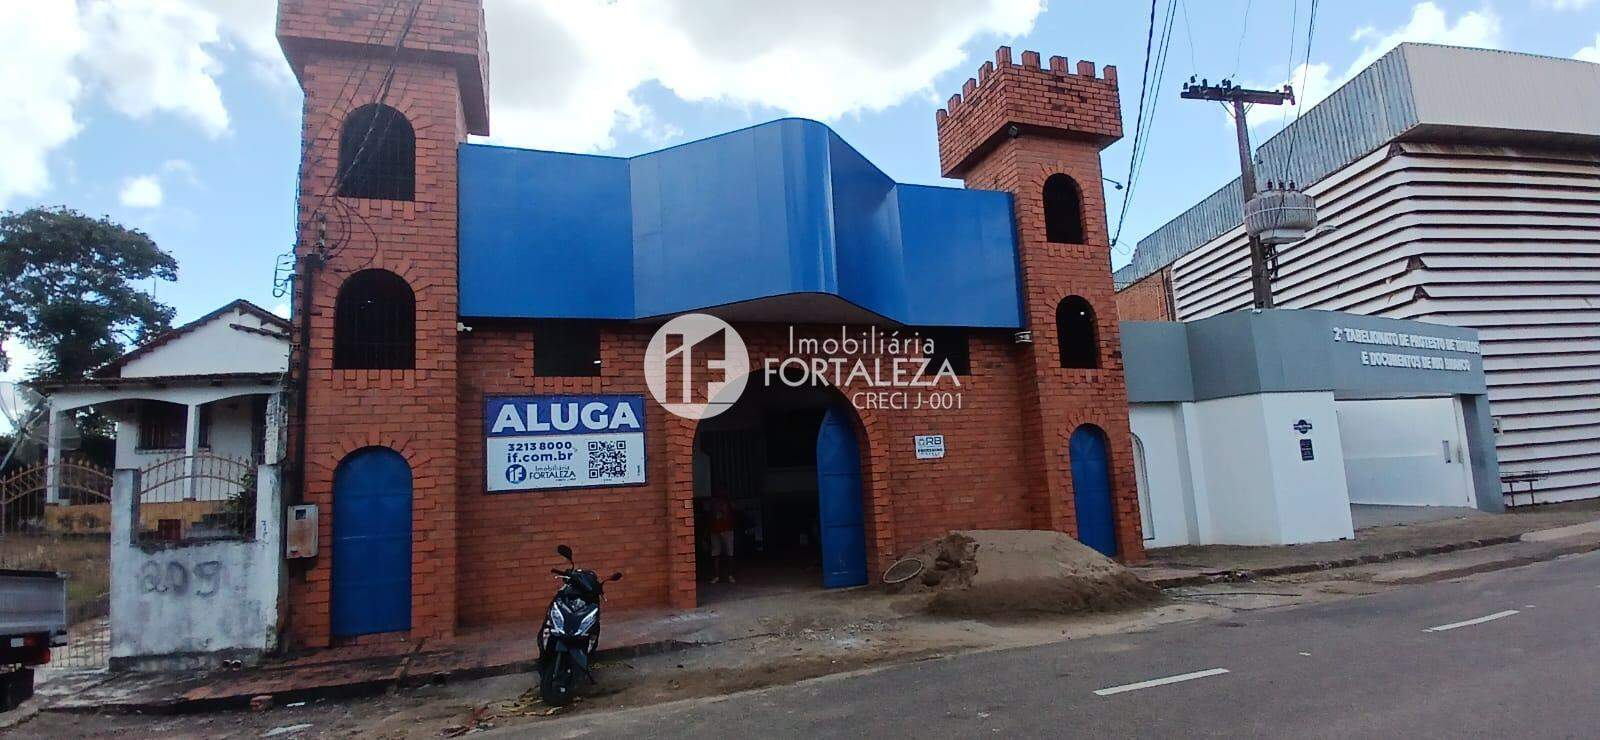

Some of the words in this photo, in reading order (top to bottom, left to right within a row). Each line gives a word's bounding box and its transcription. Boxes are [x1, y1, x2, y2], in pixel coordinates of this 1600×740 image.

[1399, 333, 1409, 347] DE
[1409, 335, 1446, 351] PROTESTO
[1361, 351, 1369, 366] E
[1370, 352, 1421, 369] DOCUMENTOS
[491, 402, 641, 433] ALUGA
[507, 442, 537, 452] 3213
[539, 441, 572, 451] 8000
[507, 451, 573, 463] if.com.br
[529, 470, 576, 480] FORTALEZA
